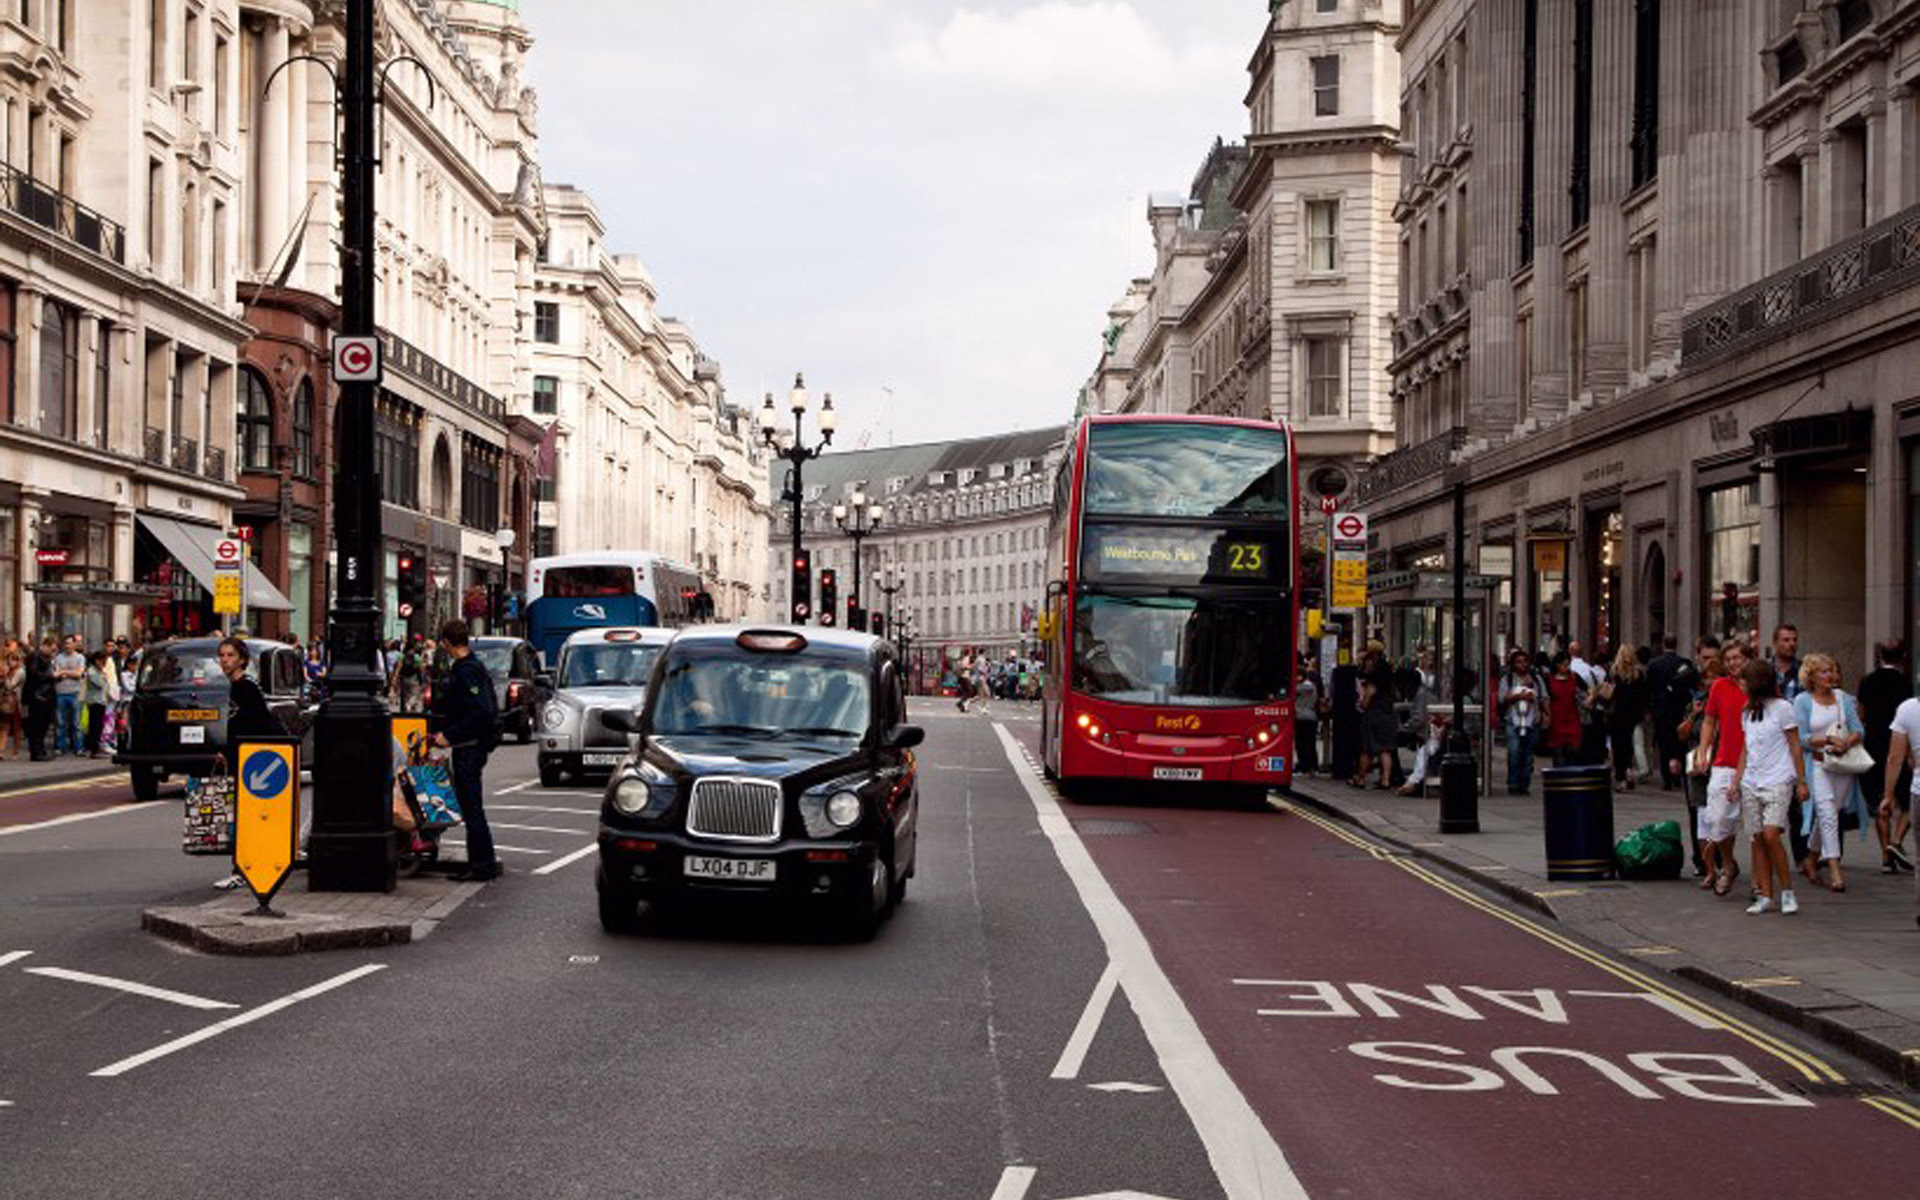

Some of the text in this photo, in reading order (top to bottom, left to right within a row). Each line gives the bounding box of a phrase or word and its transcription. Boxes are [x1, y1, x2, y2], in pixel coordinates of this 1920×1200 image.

[1322, 498, 1336, 510] M
[240, 526, 251, 538] T
[1229, 544, 1262, 570] 23
[690, 858, 770, 877] LX04 DJF
[1232, 978, 1726, 1029] LANE
[1347, 1041, 1816, 1107] BUS
